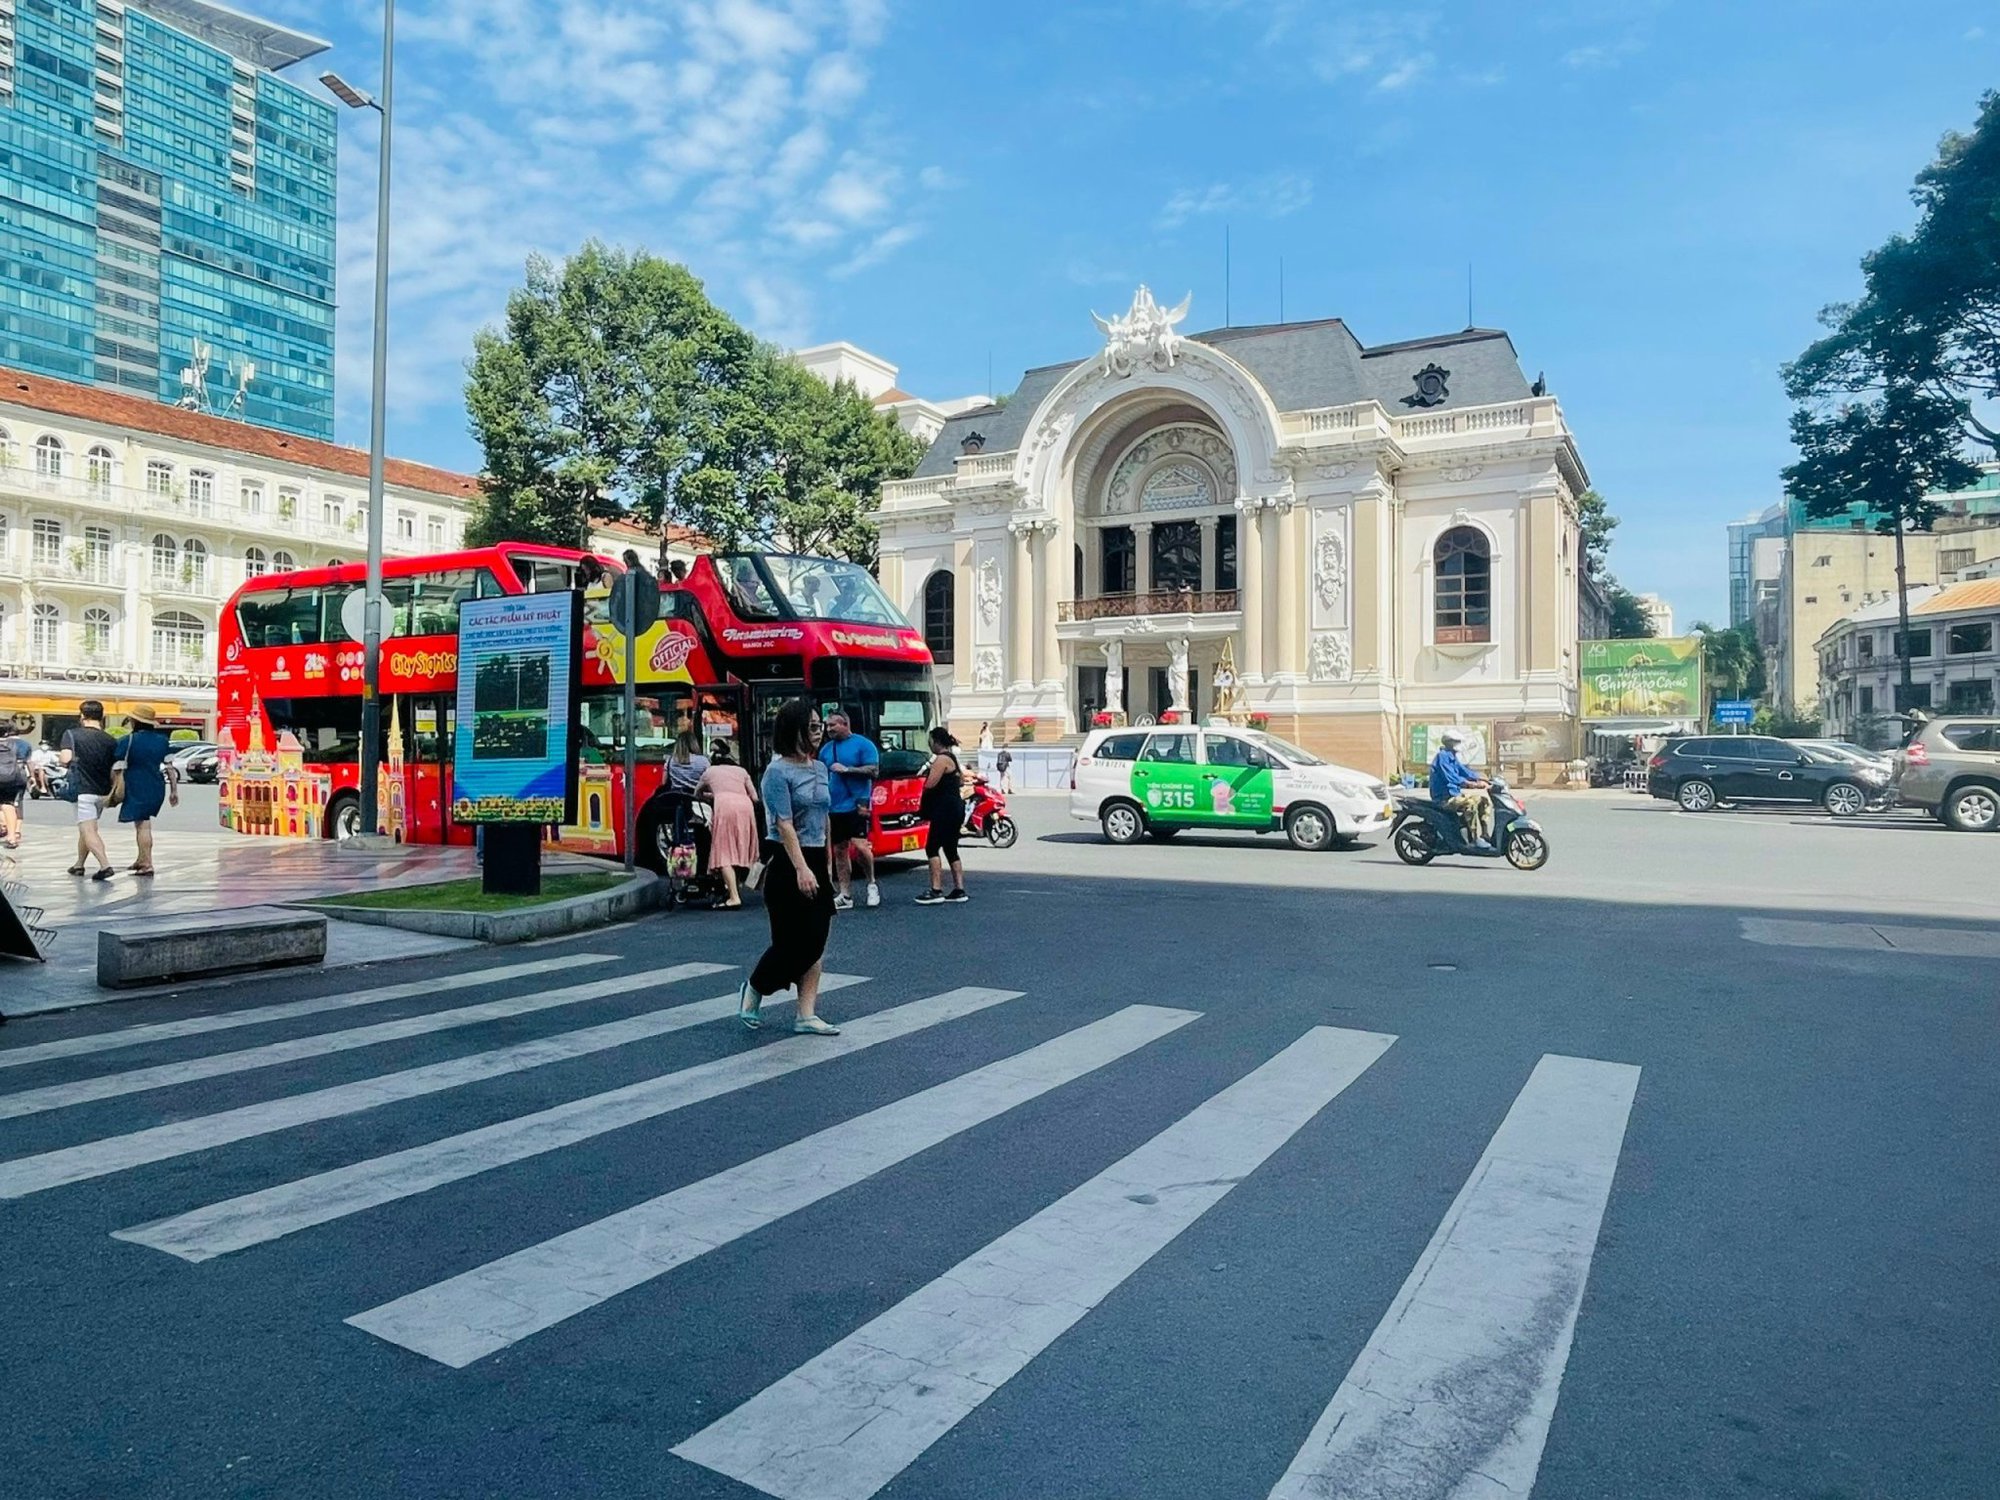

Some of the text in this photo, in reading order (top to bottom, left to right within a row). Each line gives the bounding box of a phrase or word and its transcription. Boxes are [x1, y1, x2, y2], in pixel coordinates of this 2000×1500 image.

[390, 650, 457, 680] CitySights
[652, 638, 695, 668] OFFICIAL
[64, 667, 218, 690] CONTINENTA
[1162, 791, 1195, 808] 315
